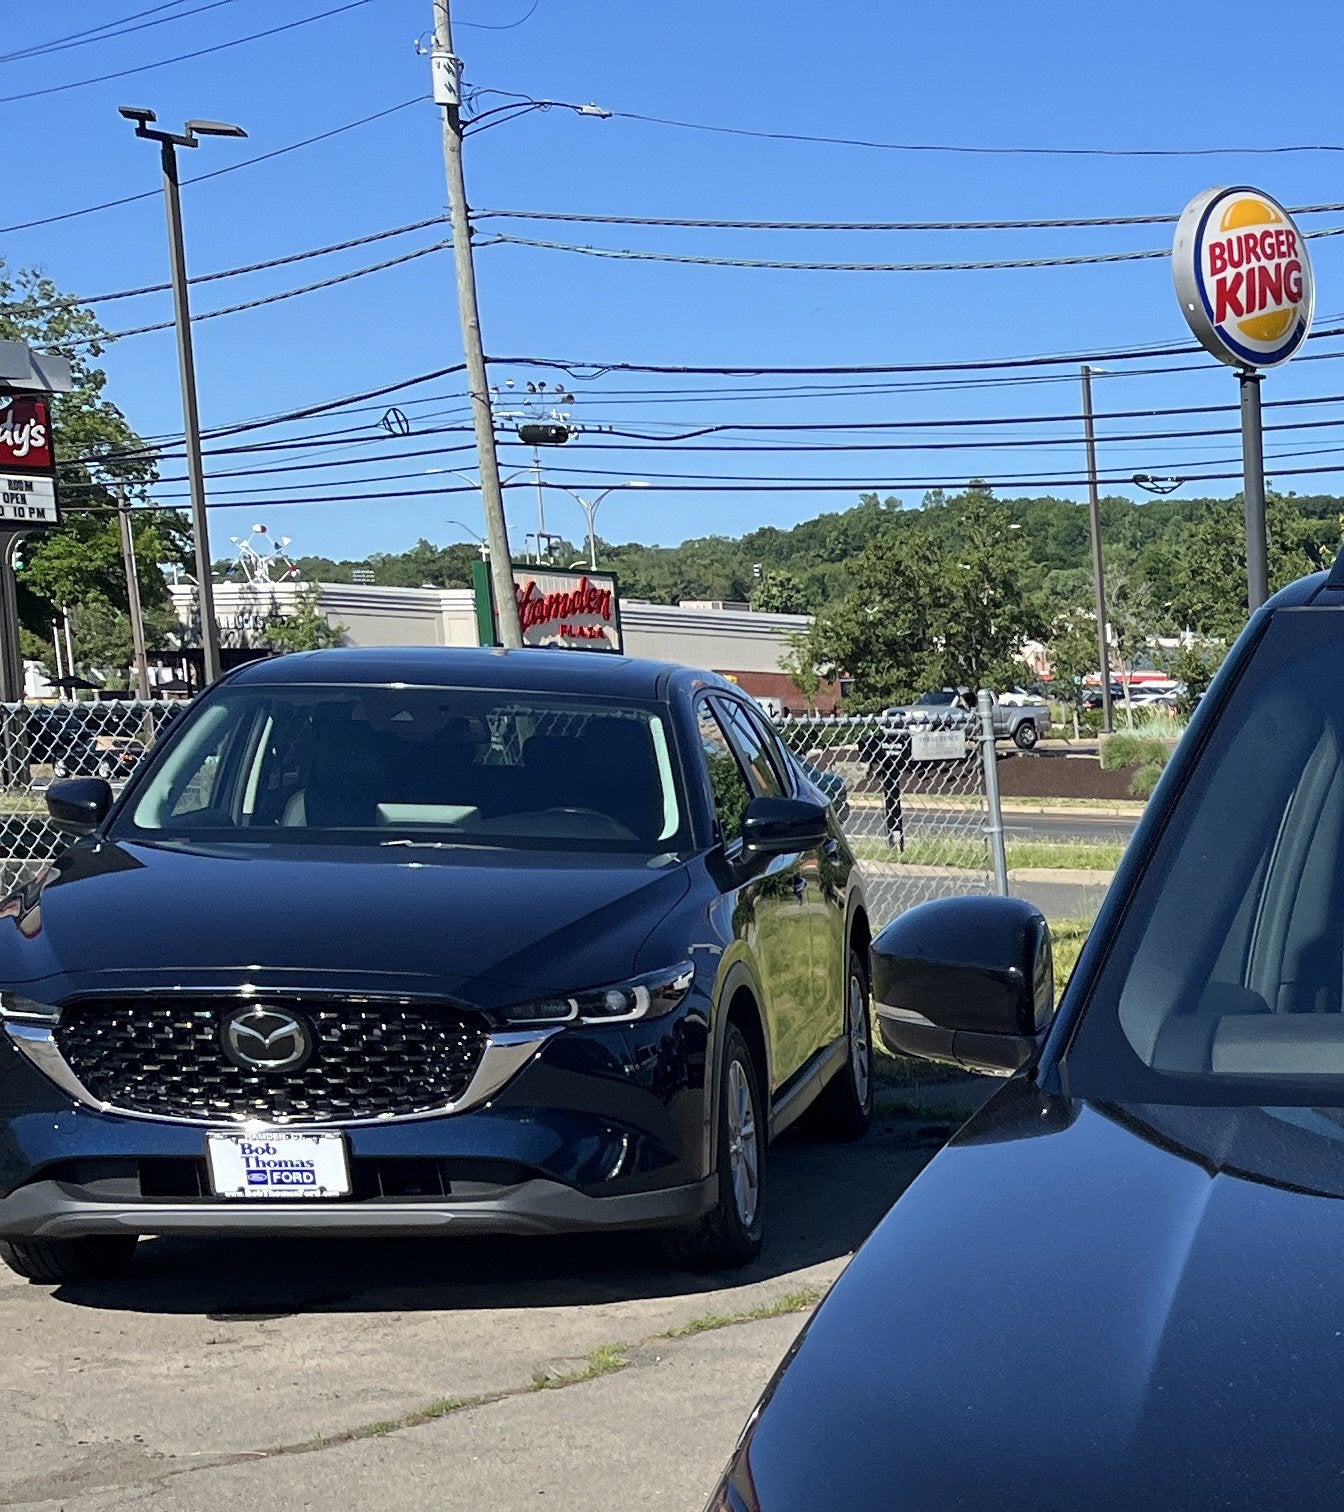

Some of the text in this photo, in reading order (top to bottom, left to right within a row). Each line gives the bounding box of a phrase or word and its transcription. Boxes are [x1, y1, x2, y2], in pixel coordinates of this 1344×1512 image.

[1208, 230, 1299, 277] BURGER
[1215, 260, 1303, 324] KING
[3, 493, 27, 505] OPEN
[13, 507, 24, 518] 10
[29, 507, 45, 518] PM
[559, 625, 606, 639] PLAZA
[241, 1143, 277, 1155] Bob
[241, 1156, 314, 1168] Thomas
[272, 1172, 314, 1183] FORD
